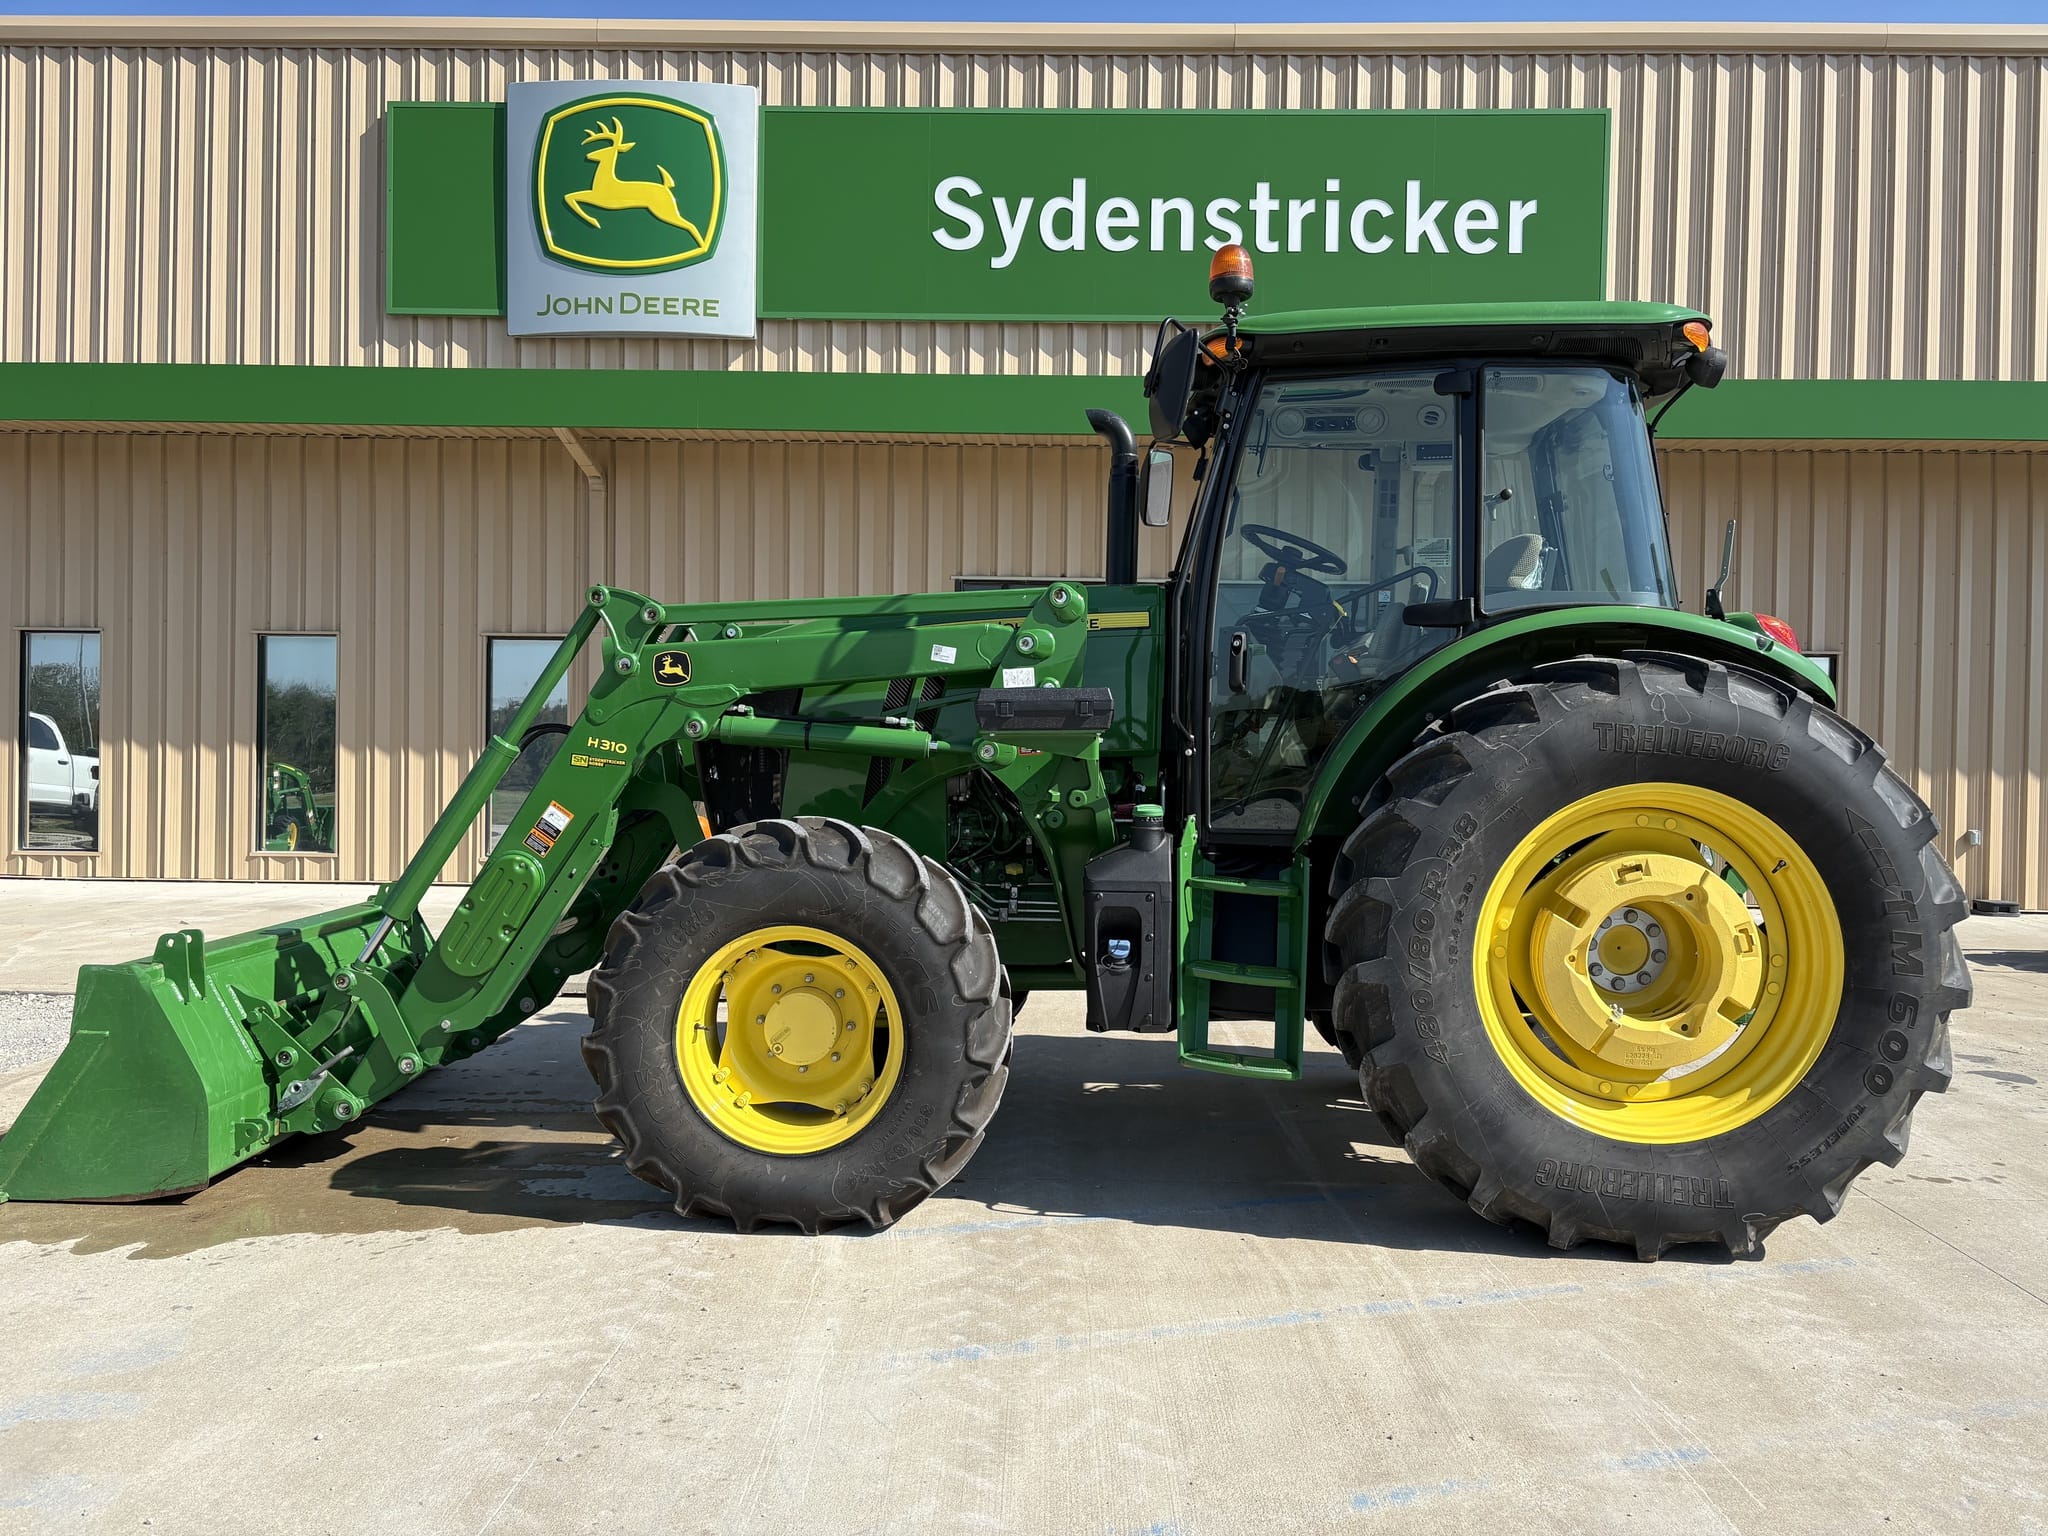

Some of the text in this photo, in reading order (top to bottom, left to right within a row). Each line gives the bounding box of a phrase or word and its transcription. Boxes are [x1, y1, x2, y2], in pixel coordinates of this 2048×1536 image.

[932, 175, 1538, 269] Sydenstricker
[536, 292, 720, 318] JOHN DEERE
[587, 736, 628, 754] H310
[1593, 721, 1792, 772] TRELLEBORG
[1534, 1157, 1736, 1210] TRELLEBORG
